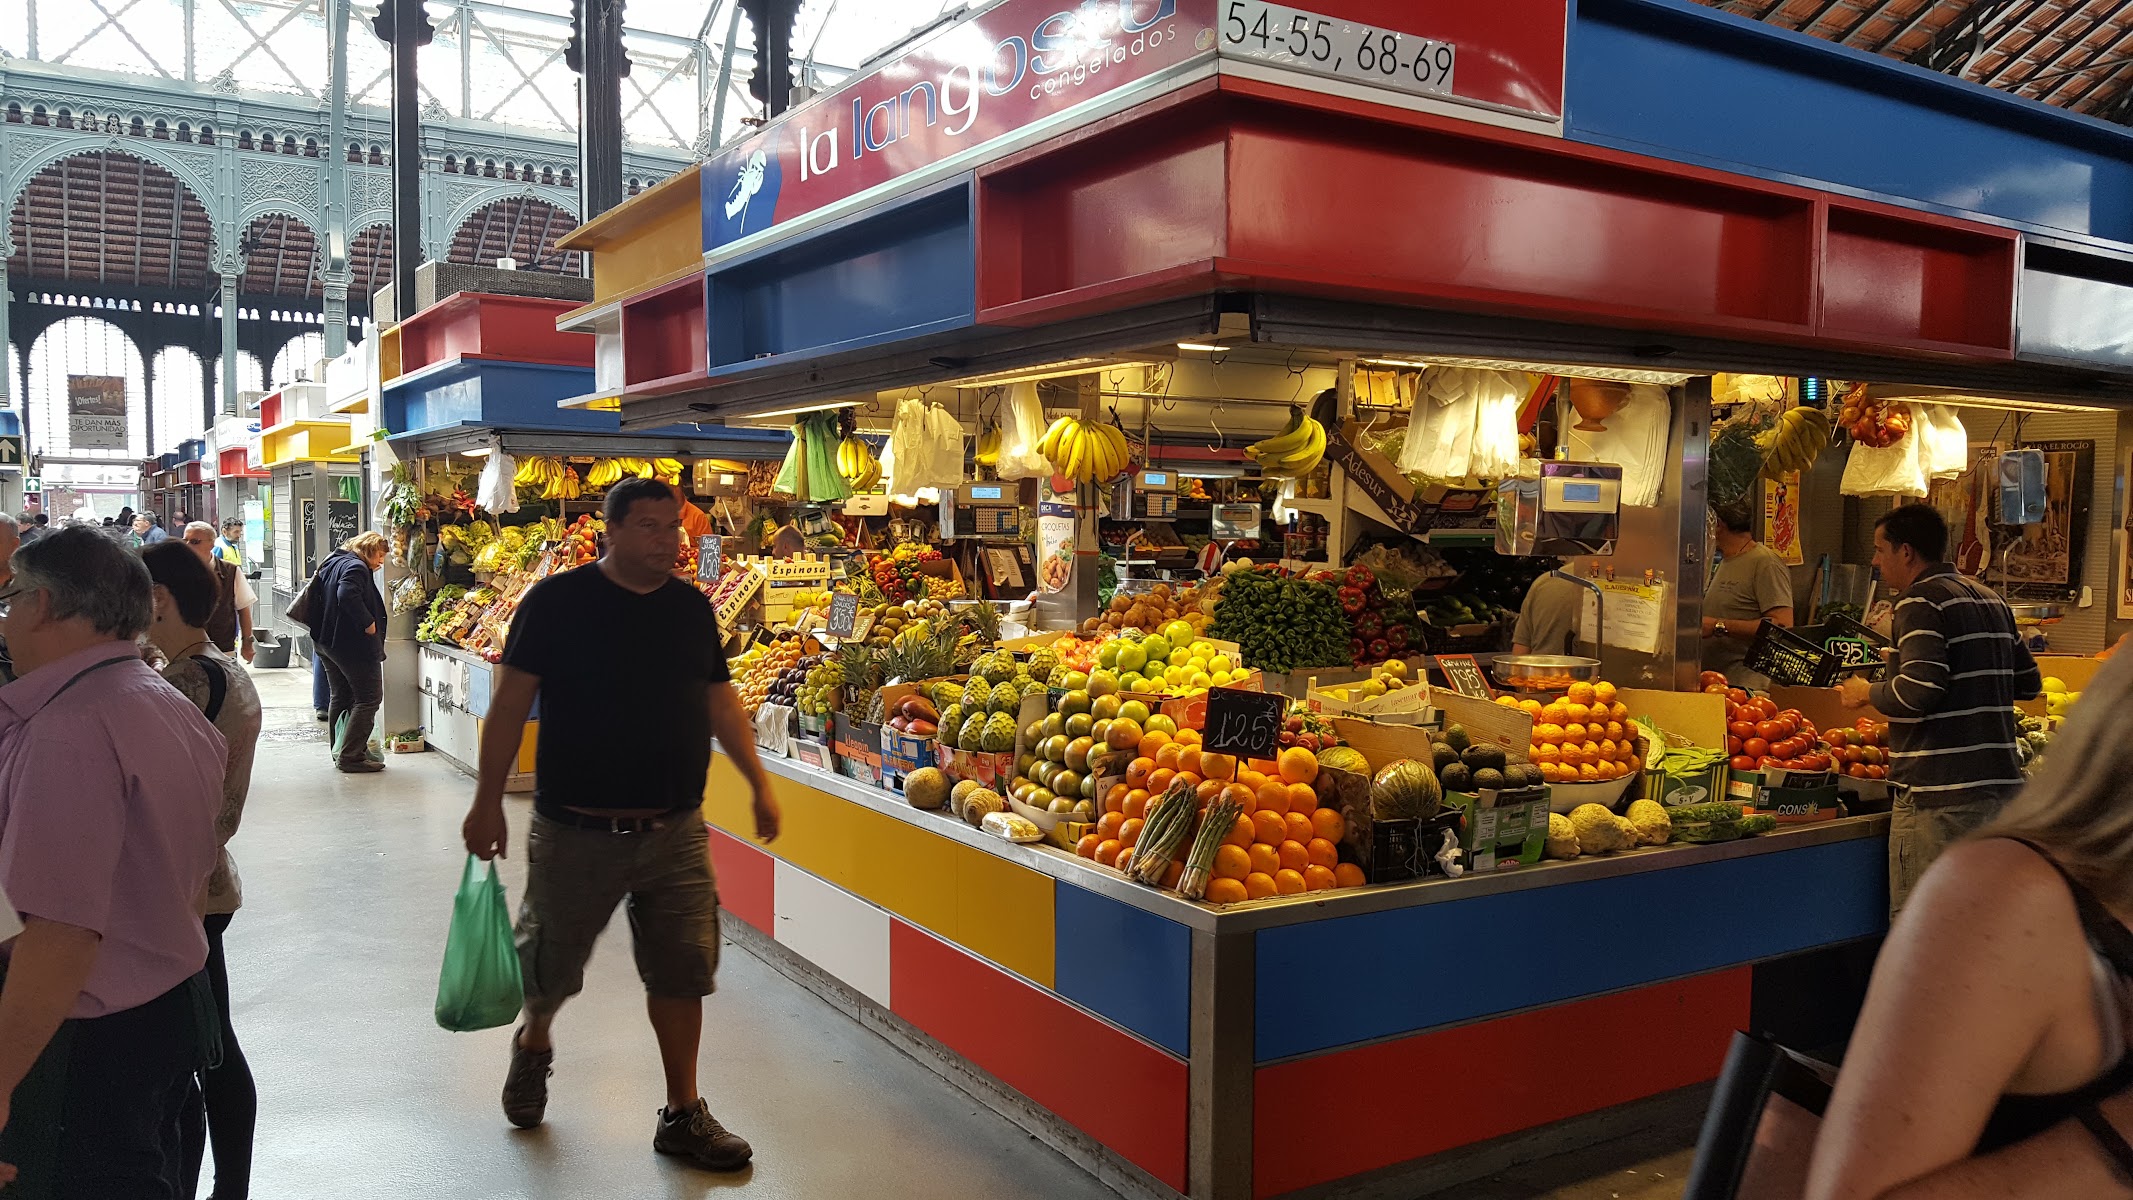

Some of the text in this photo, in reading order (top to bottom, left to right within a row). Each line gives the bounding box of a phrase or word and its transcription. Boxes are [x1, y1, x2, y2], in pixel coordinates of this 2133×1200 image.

[1030, 23, 1176, 100] congelados
[1225, 1, 1453, 86] 54-55, 68-69
[800, 126, 839, 182] la
[70, 424, 126, 433] OPORTUNIDAD
[75, 418, 121, 427] TE DAN MÁS
[1341, 450, 1386, 498] Adesur
[772, 565, 827, 577] Espinosa
[718, 572, 760, 620] Espinosa
